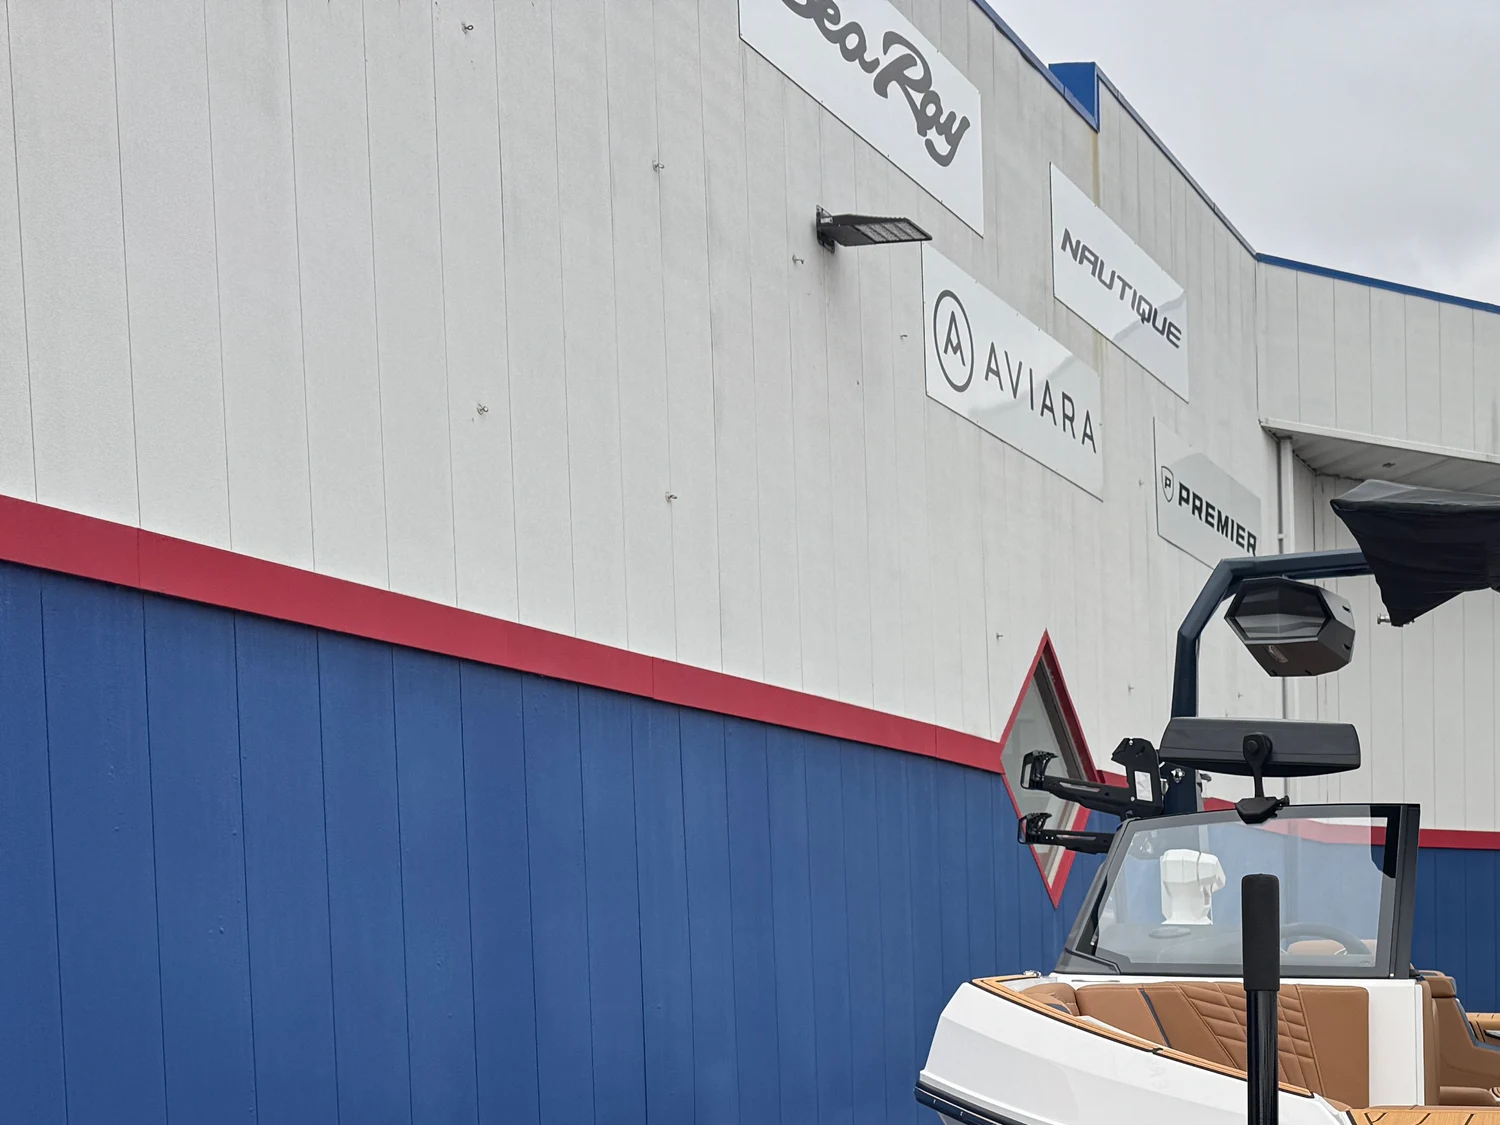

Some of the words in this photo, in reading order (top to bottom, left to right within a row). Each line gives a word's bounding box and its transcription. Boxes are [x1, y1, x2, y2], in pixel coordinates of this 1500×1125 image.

[873, 31, 971, 167] Ray
[1060, 227, 1182, 349] NAUTIQUE
[984, 341, 1097, 454] AVIARA
[1178, 481, 1257, 557] PREMIER
